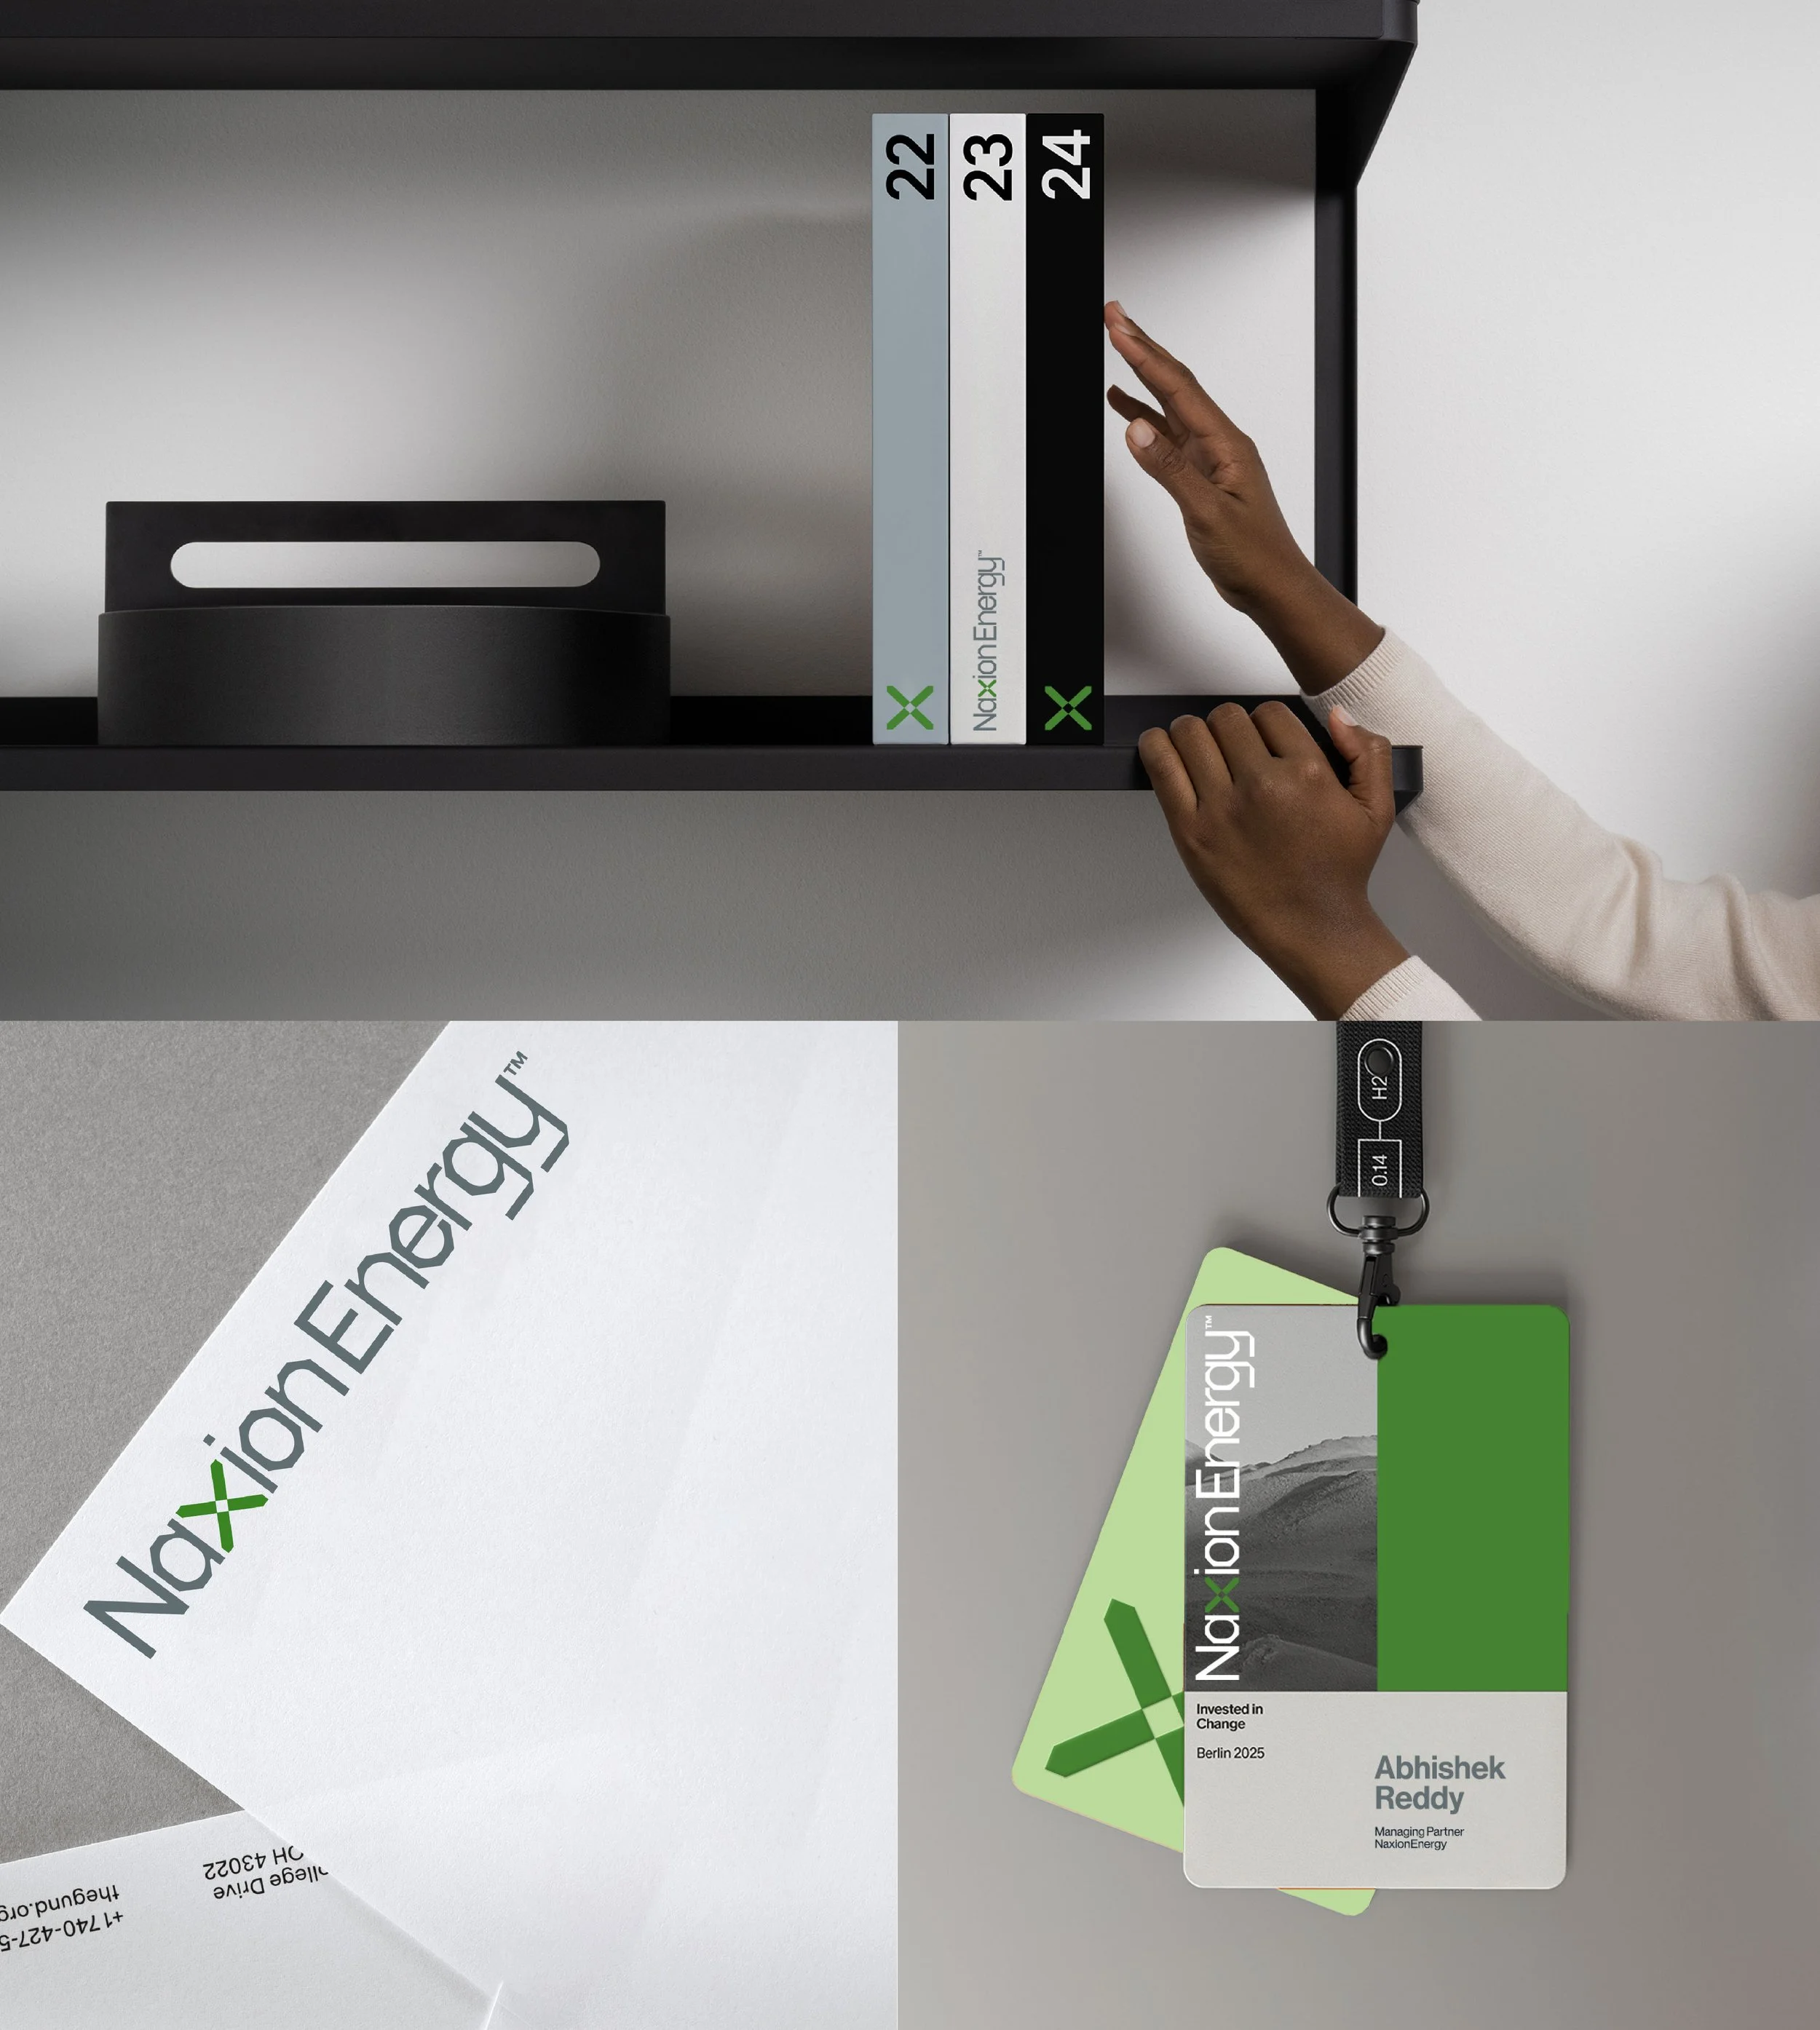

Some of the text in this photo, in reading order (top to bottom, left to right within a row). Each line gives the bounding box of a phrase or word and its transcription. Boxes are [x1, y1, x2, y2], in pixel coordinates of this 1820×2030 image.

[886, 134, 935, 200] 22
[963, 134, 1013, 201] 23
[1042, 130, 1091, 199] 24
[1372, 1076, 1388, 1100] H2
[1372, 1154, 1388, 1186] 0.14
[1196, 1703, 1263, 1715] Invested in
[1196, 1718, 1246, 1732] Change
[1196, 1747, 1265, 1759] Berlin 2025
[1374, 1755, 1506, 1780] Abhishek
[1375, 1785, 1464, 1815] Reddy
[1374, 1826, 1465, 1839] Managing Partner
[1374, 1839, 1447, 1851] NaxionEnergy
[202, 1852, 266, 1880] 43022
[213, 1877, 265, 1899] Drive
